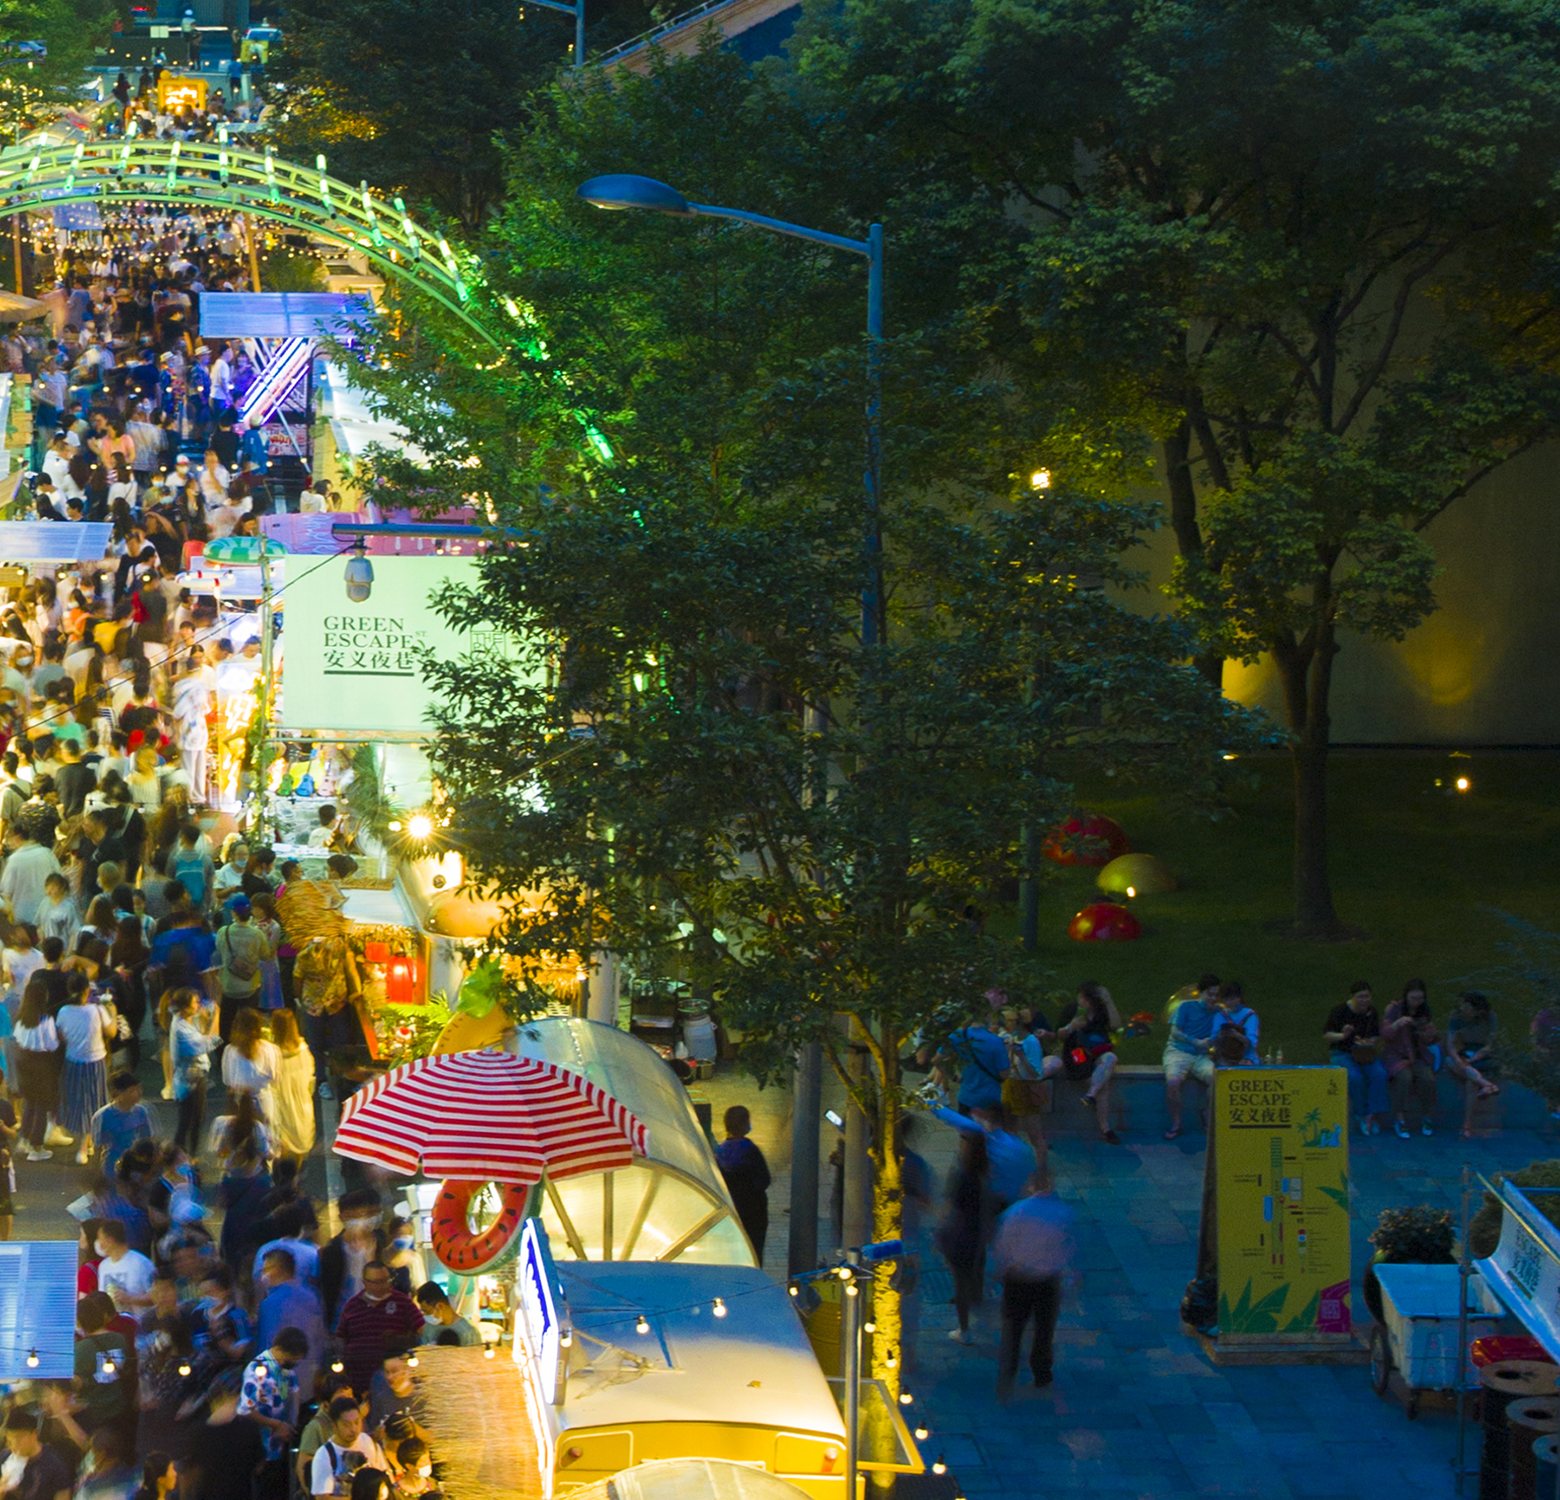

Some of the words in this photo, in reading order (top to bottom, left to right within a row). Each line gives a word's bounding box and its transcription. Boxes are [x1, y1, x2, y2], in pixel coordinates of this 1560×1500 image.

[323, 615, 405, 632] GREEN
[323, 632, 415, 650] ESCAPE
[323, 650, 415, 671] 安义夜巷
[1229, 1079, 1286, 1093] GREEN
[1229, 1093, 1292, 1107] ESCAPE
